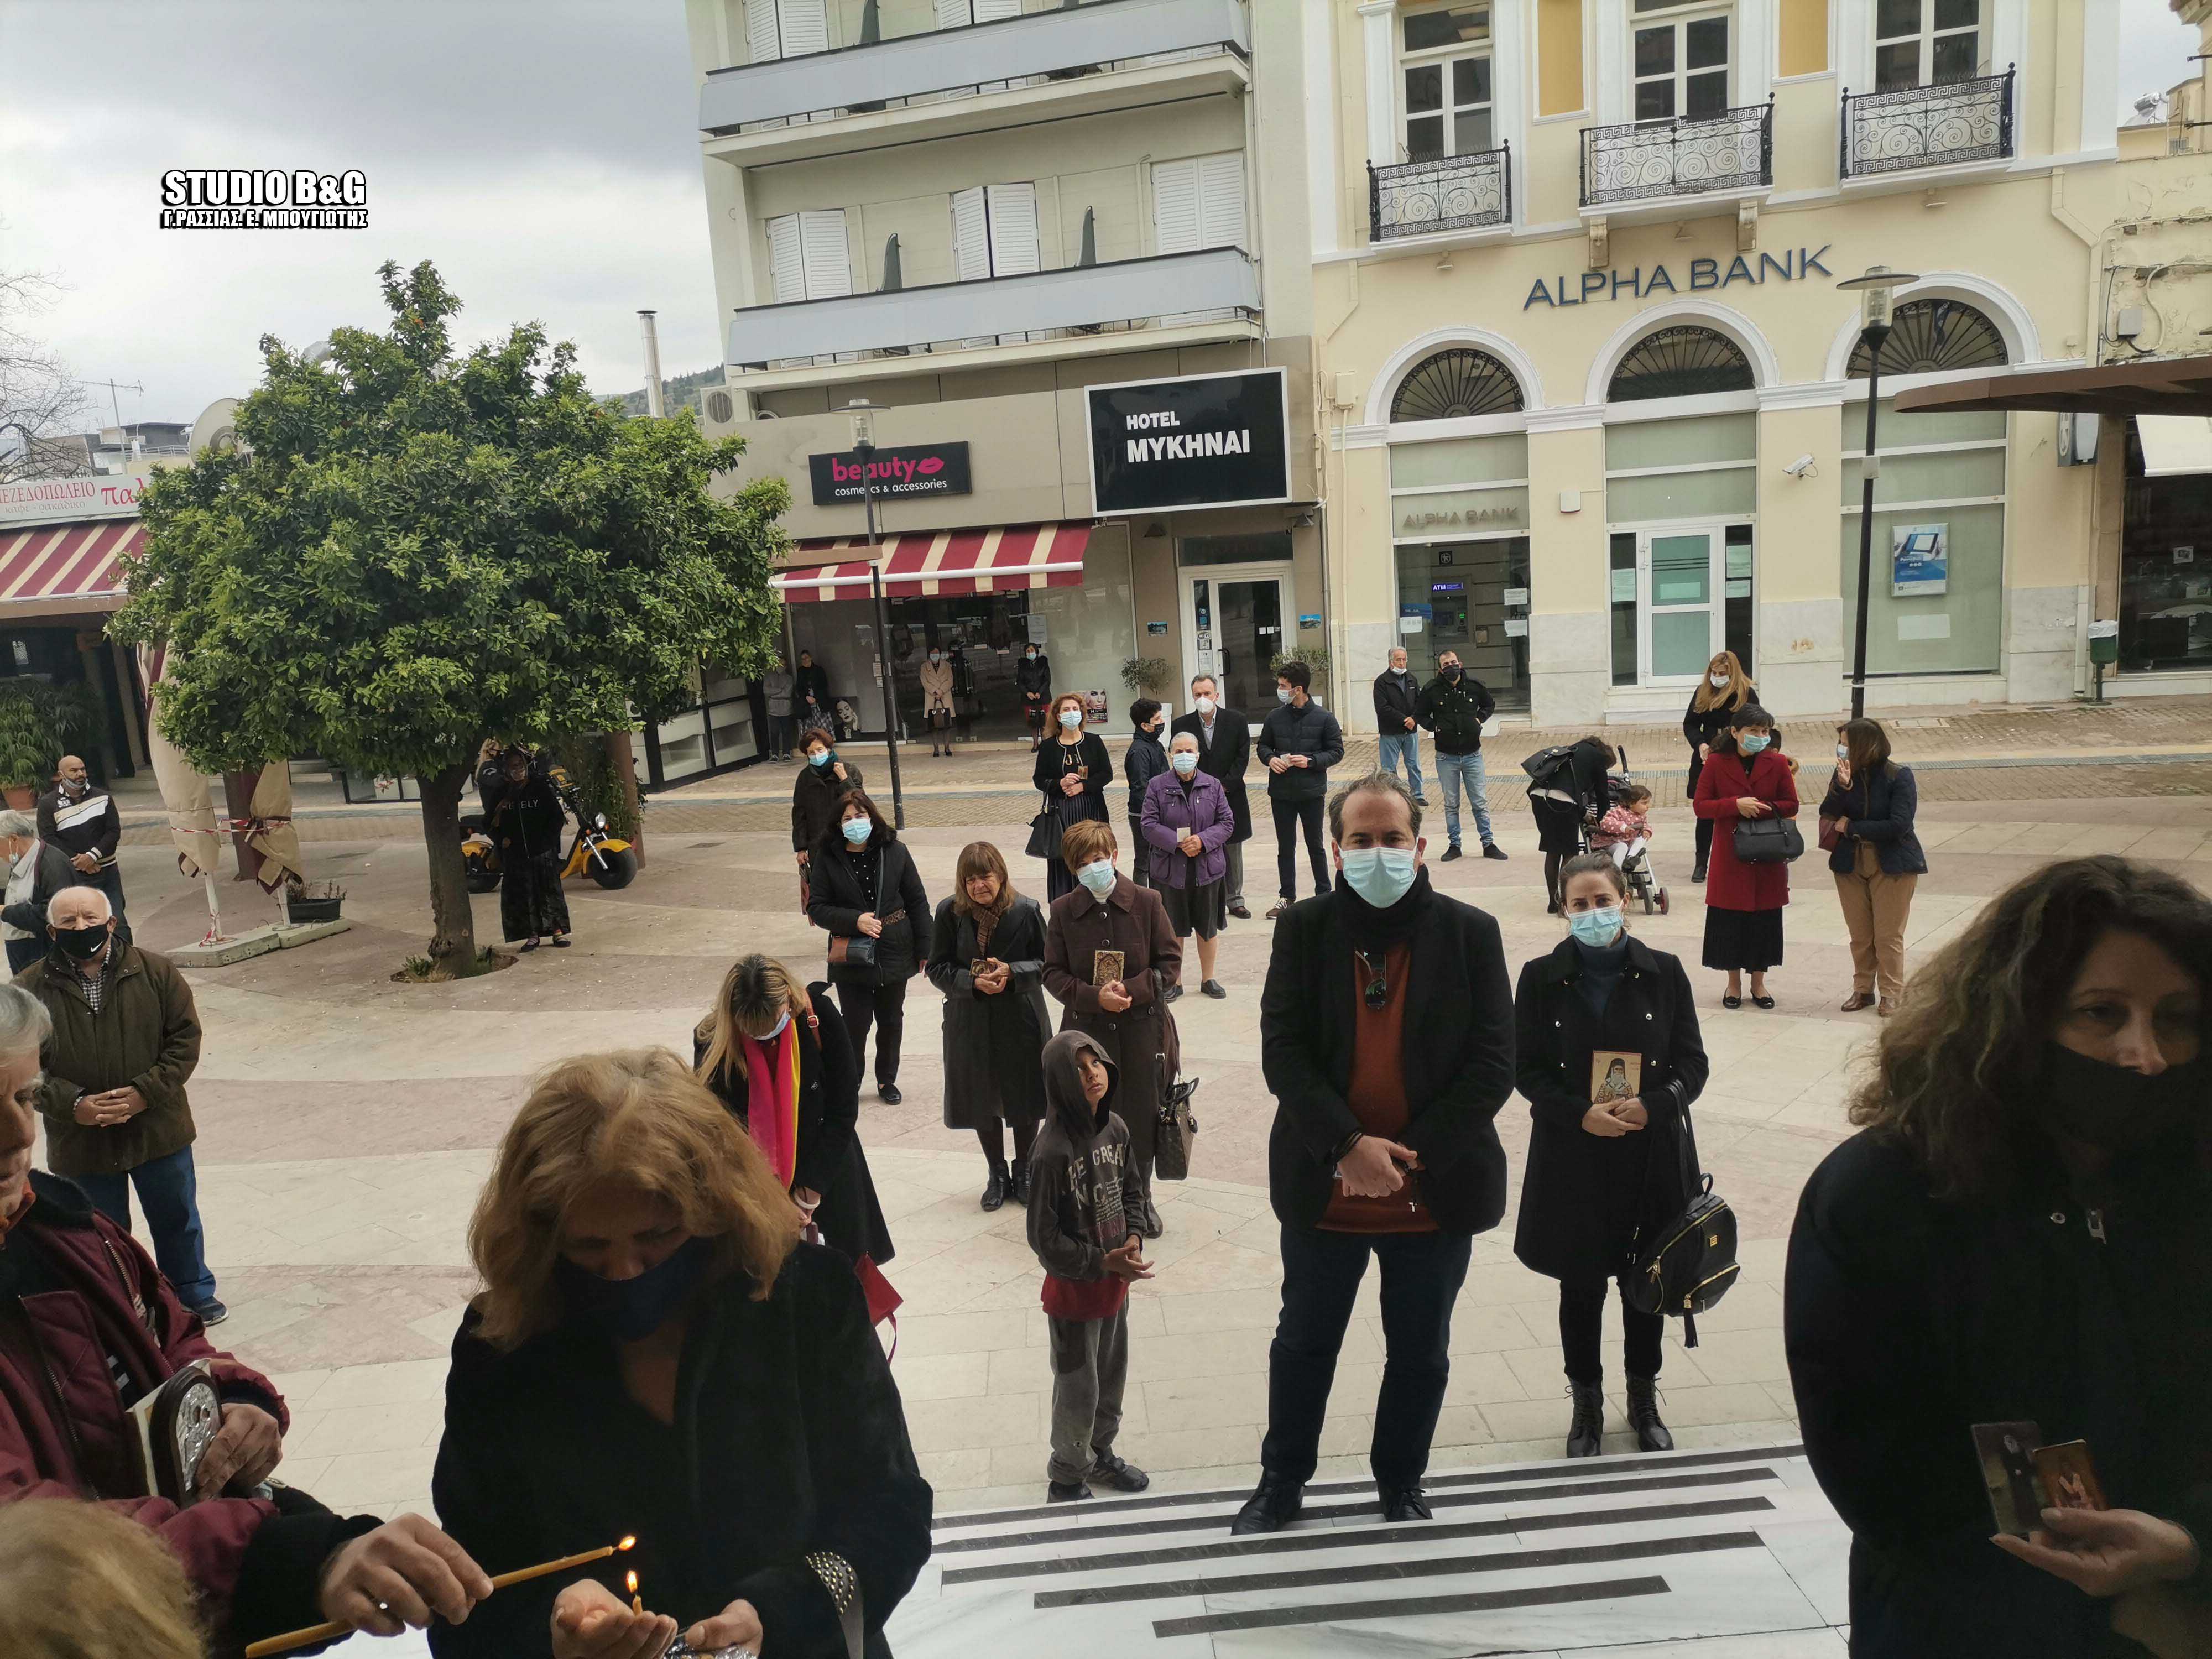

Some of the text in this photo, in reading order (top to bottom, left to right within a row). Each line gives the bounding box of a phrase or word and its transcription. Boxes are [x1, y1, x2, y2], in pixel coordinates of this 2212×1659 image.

[1524, 243, 1834, 311] ALPHA BANK
[1126, 411, 1180, 430] HOTEL
[832, 456, 916, 483] beauty
[834, 478, 947, 496] cosmecs & accessories
[1403, 507, 1519, 529] ALPHA BANK
